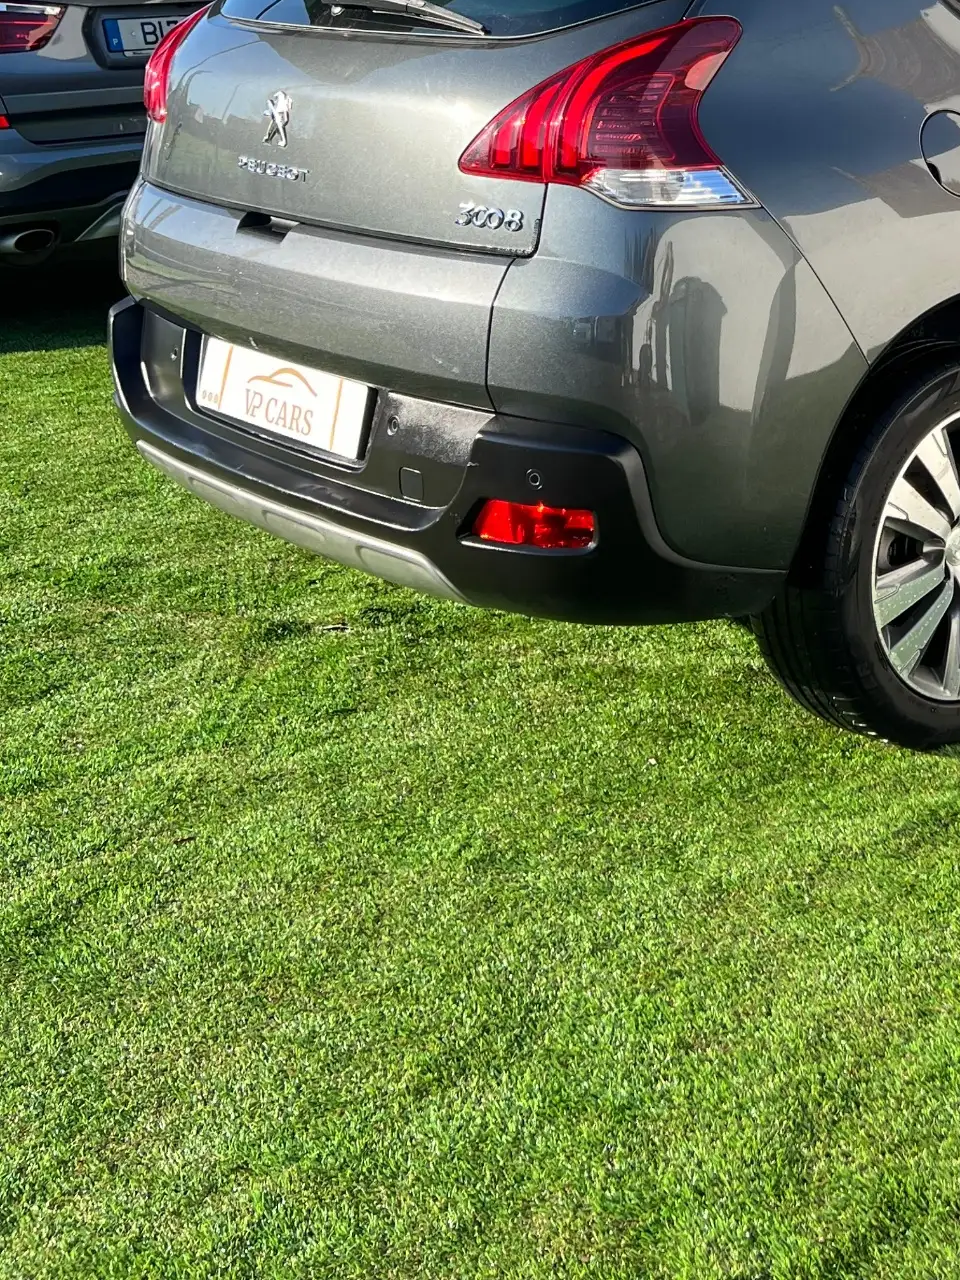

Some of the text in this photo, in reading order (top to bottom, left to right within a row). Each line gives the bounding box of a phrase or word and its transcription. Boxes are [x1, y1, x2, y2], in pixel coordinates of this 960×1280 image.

[238, 156, 309, 183] PEUGEOT
[455, 201, 524, 233] 3008
[245, 388, 315, 437] VP CARS
